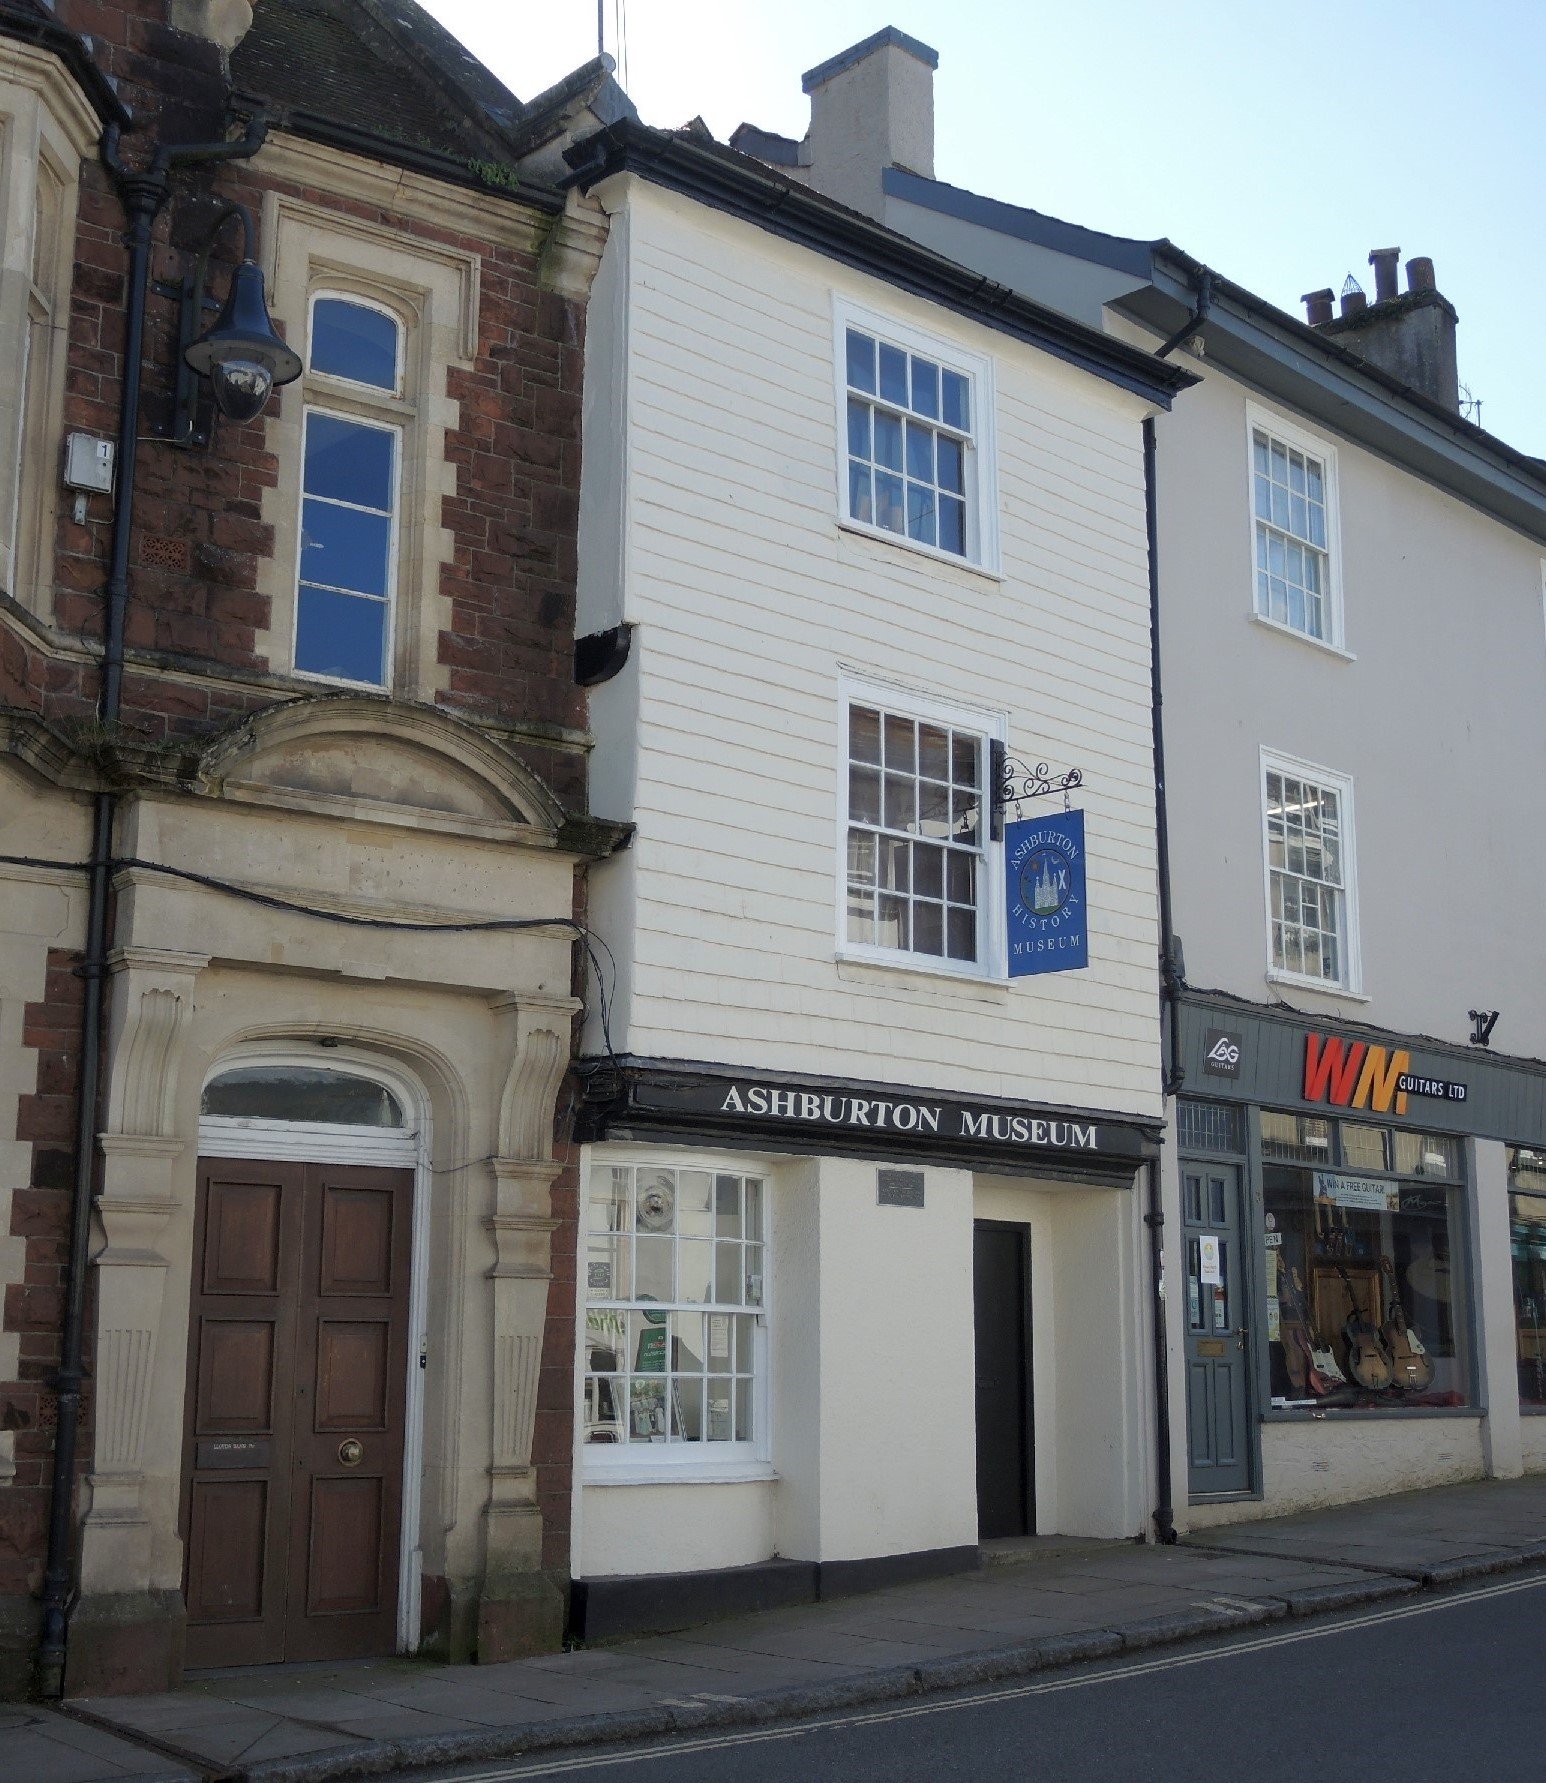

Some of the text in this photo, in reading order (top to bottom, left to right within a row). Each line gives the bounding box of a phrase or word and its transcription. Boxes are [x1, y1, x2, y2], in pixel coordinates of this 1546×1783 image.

[102, 445, 107, 457] 1
[1011, 831, 1078, 870] ASHBURTON
[1012, 894, 1079, 931] HISTORY
[1013, 935, 1079, 954] MUSEUM
[1210, 1060, 1235, 1071] GUITARS
[1399, 1075, 1465, 1099] GUITARS LTD
[720, 1085, 942, 1132] ASHBURTON
[959, 1110, 1099, 1150] MUSEUM
[1326, 1178, 1339, 1190] WIN
[1340, 1182, 1346, 1190] A
[1346, 1181, 1361, 1192] FREE
[1265, 1234, 1279, 1244] PEN
